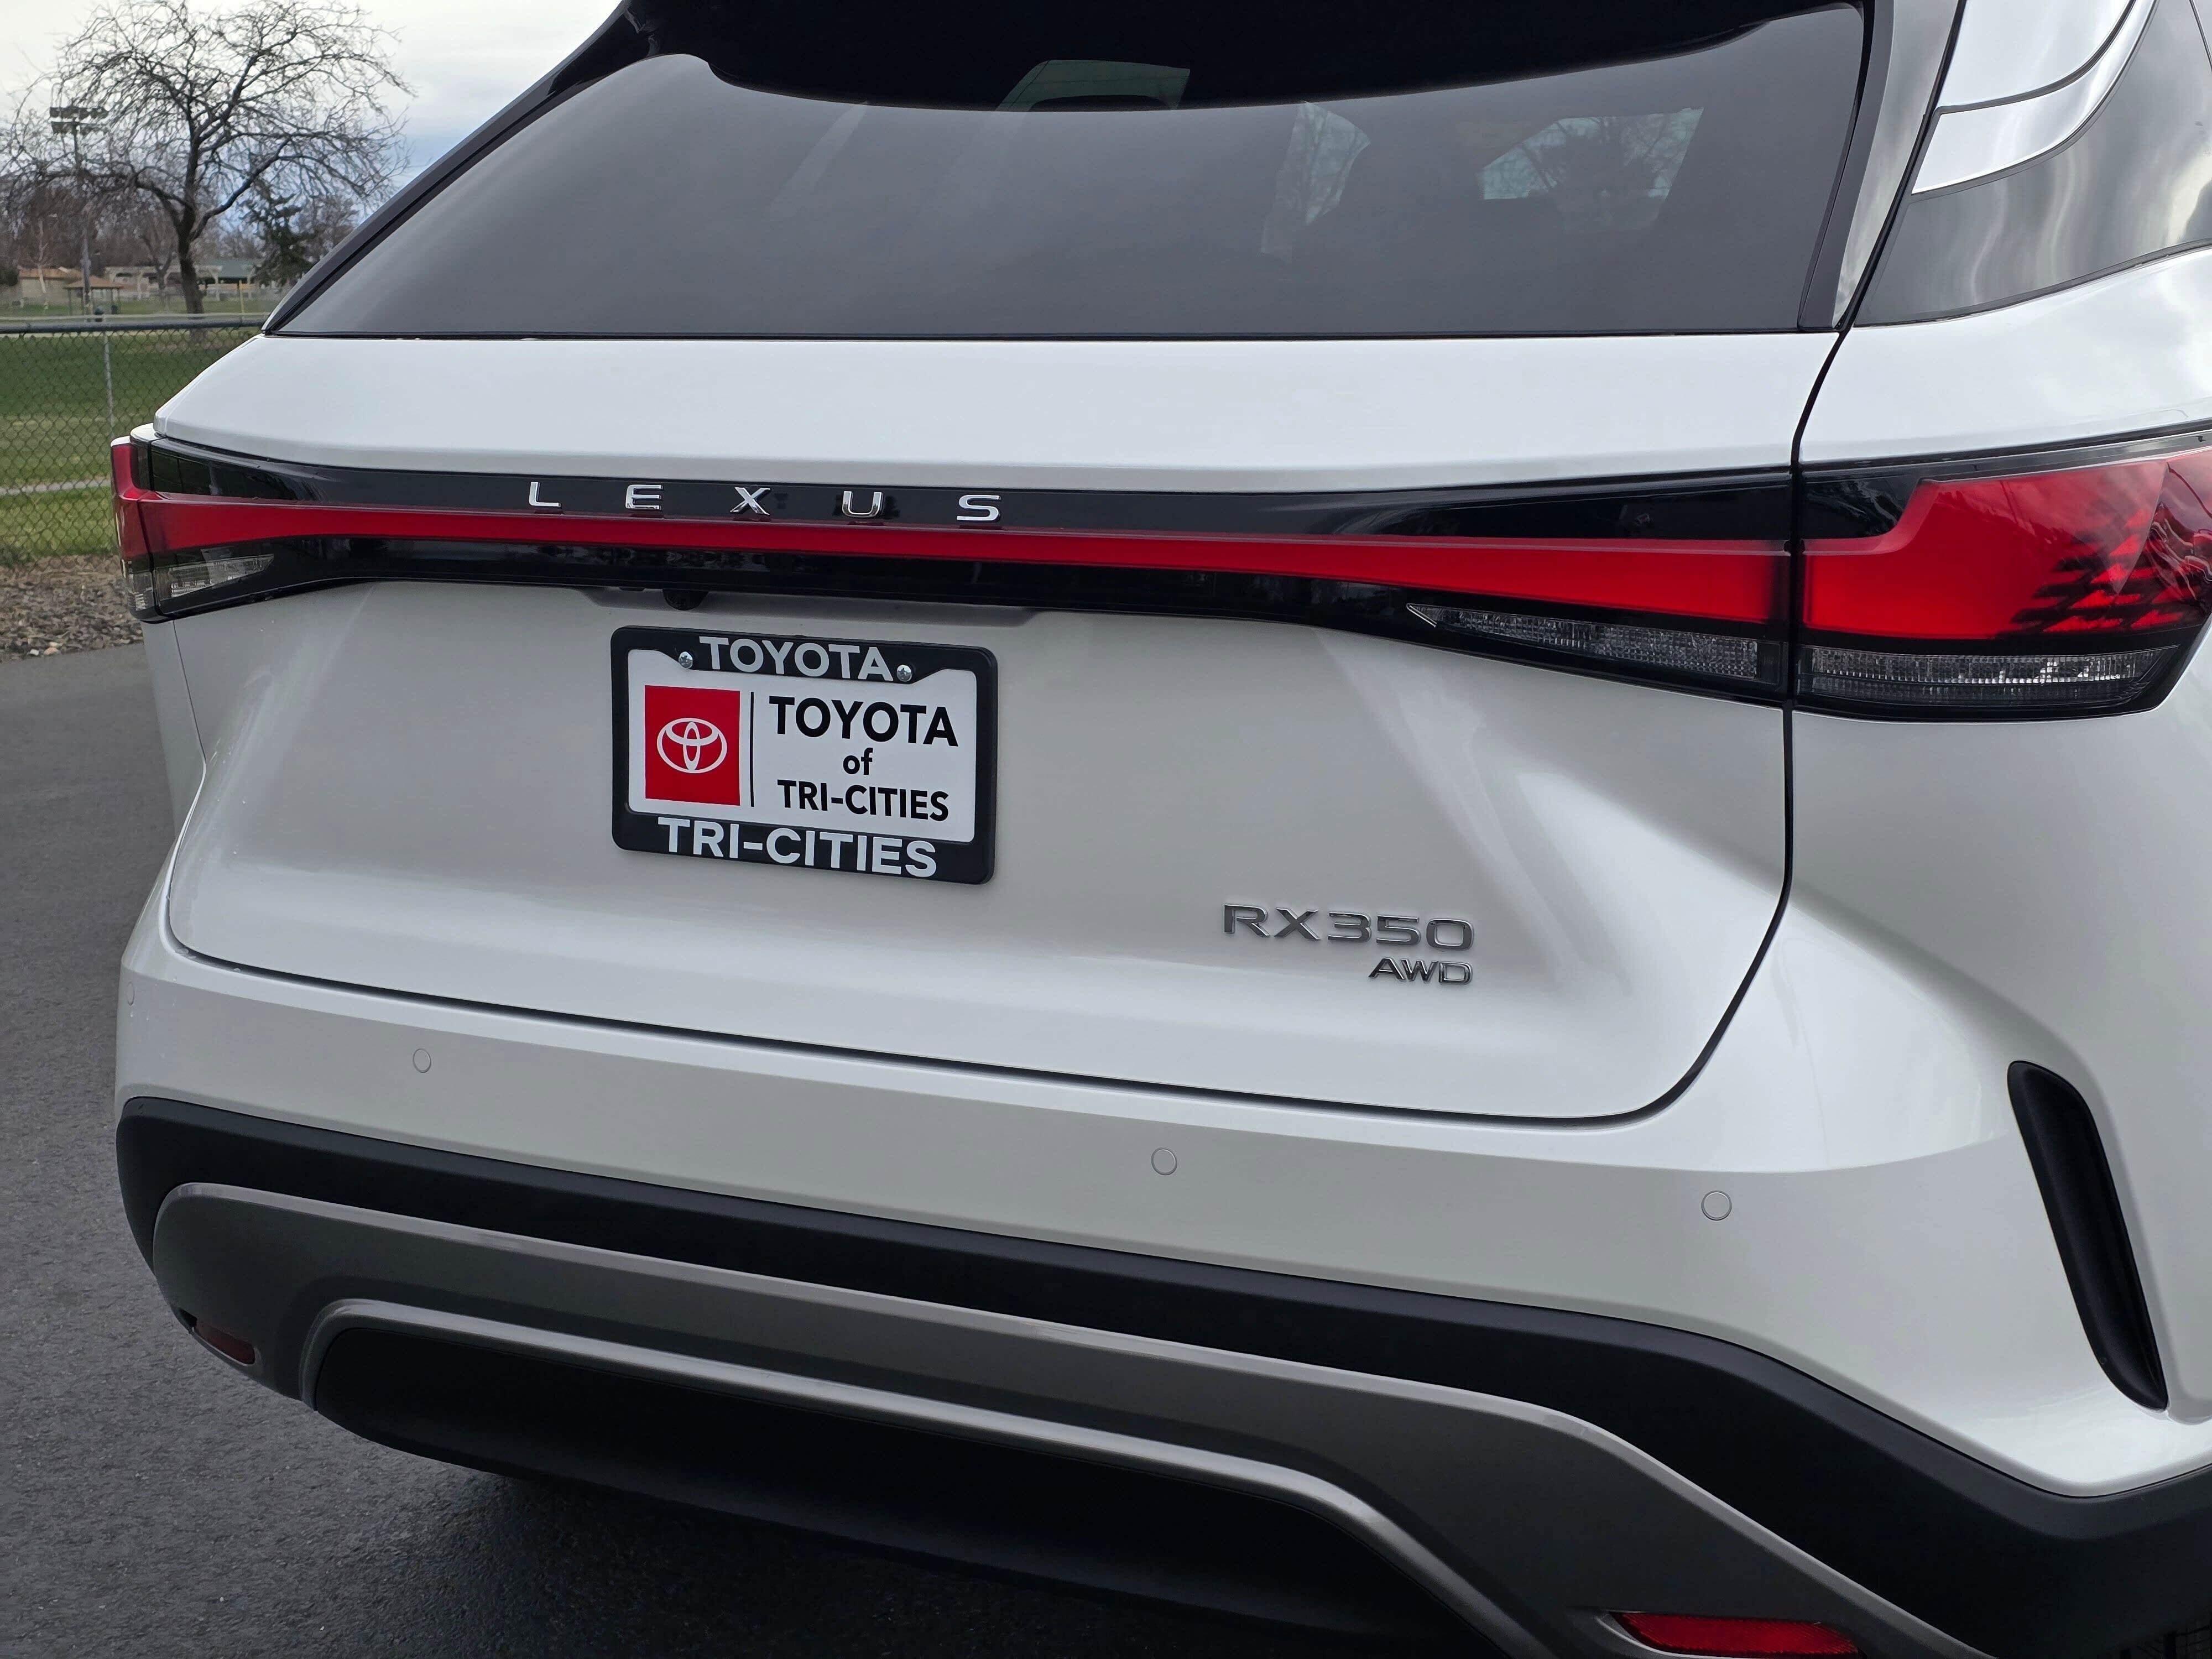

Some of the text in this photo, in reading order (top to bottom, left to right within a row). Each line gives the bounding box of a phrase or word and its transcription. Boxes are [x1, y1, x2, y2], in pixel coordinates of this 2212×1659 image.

[529, 481, 1002, 522] LEXUS
[700, 635, 894, 681] TOYOTA
[769, 695, 959, 747] TOYOTA
[843, 747, 873, 776] of
[777, 779, 949, 822] TRI-CITIES
[658, 817, 937, 878] TRI-CITIES
[1368, 957, 1473, 985] AWD
